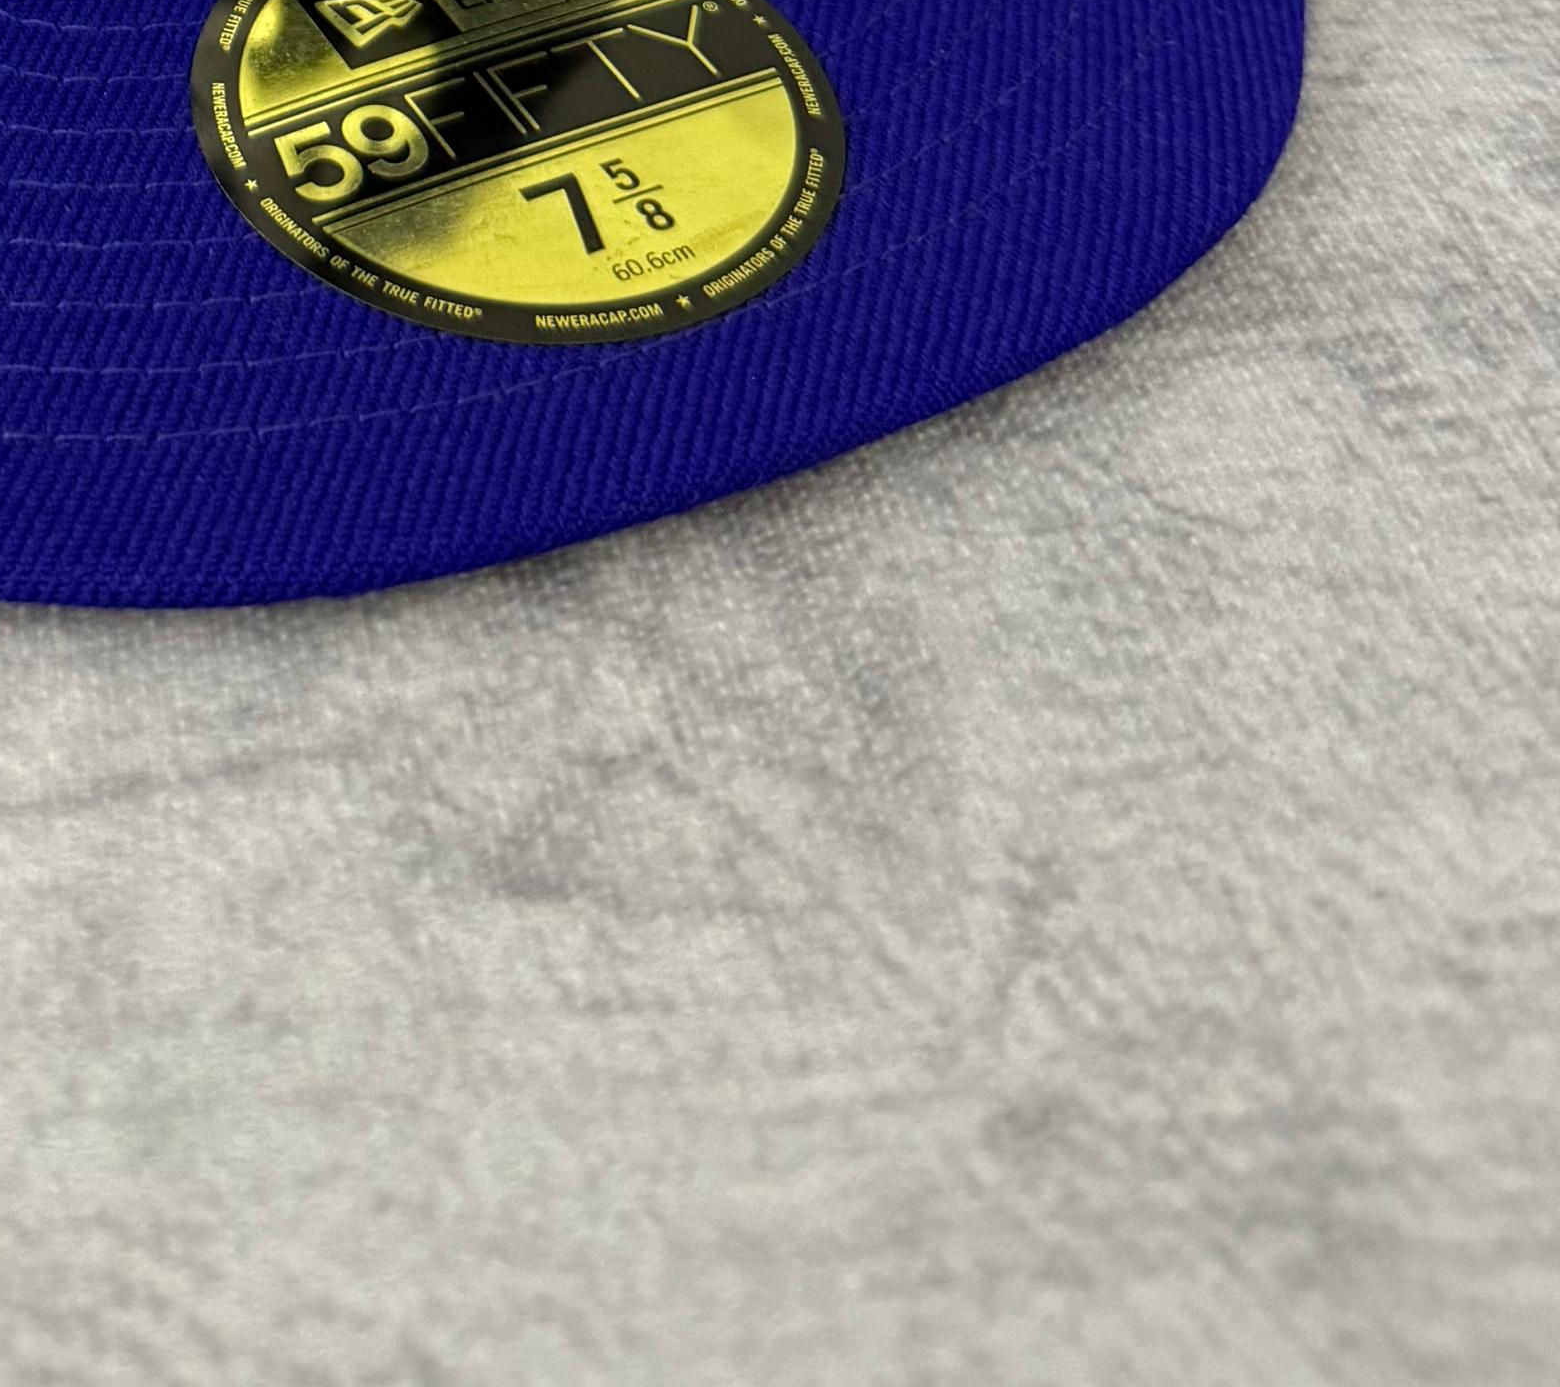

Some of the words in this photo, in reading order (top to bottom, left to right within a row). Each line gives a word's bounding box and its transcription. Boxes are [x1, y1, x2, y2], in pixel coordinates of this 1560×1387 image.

[768, 33, 821, 115] NEWERACAP.COM
[212, 82, 247, 169] NEWERACAP.COM
[260, 197, 330, 258] ORIGINATORS
[330, 254, 348, 270] OF
[350, 265, 379, 288] THE
[382, 280, 420, 305] TRUE
[519, 172, 605, 255] 7
[702, 246, 776, 298] ORIGINATORS
[770, 234, 787, 250] OF
[780, 215, 803, 235] THE
[794, 188, 816, 215] TRUE
[612, 243, 696, 282] 60.6cm
[535, 303, 664, 329] NEWERACAP.COM
